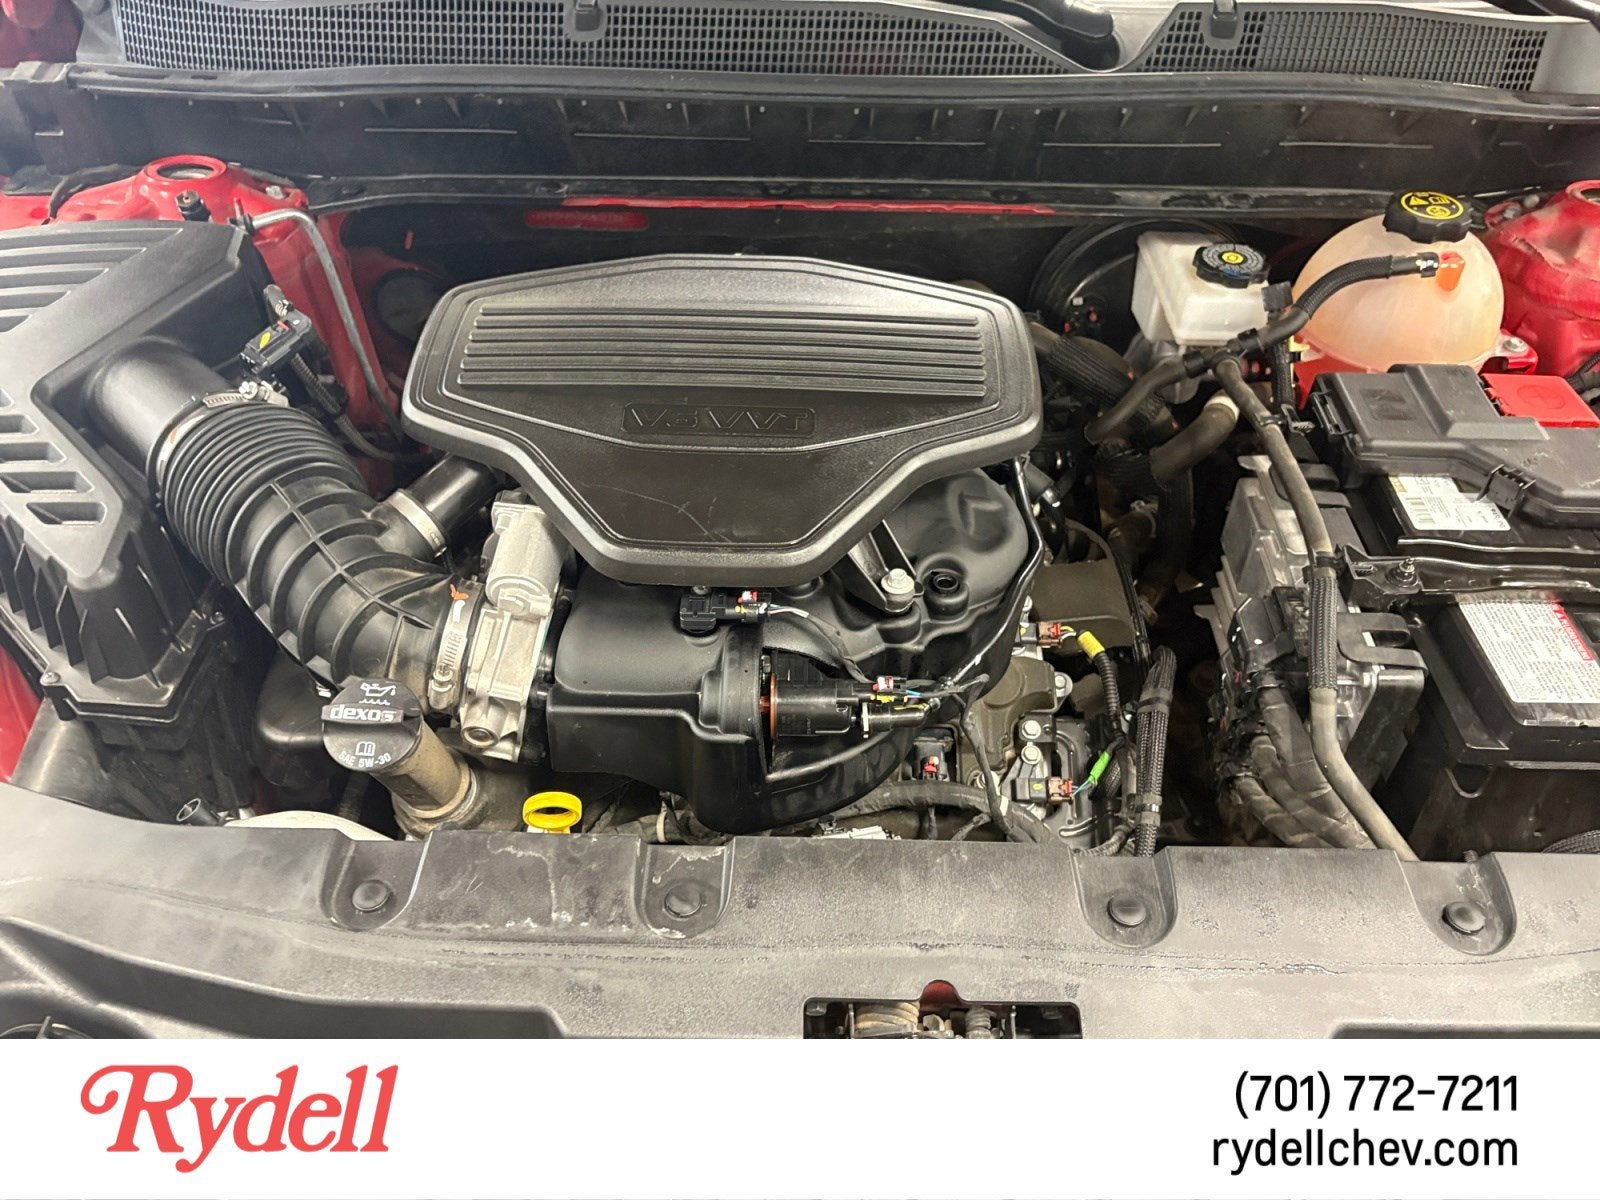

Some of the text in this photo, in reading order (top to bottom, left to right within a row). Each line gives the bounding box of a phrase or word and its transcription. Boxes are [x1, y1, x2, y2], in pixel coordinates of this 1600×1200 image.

[630, 407, 810, 431] V6 VVT
[330, 704, 397, 723] dexos
[338, 750, 392, 768] SAE 5W-30
